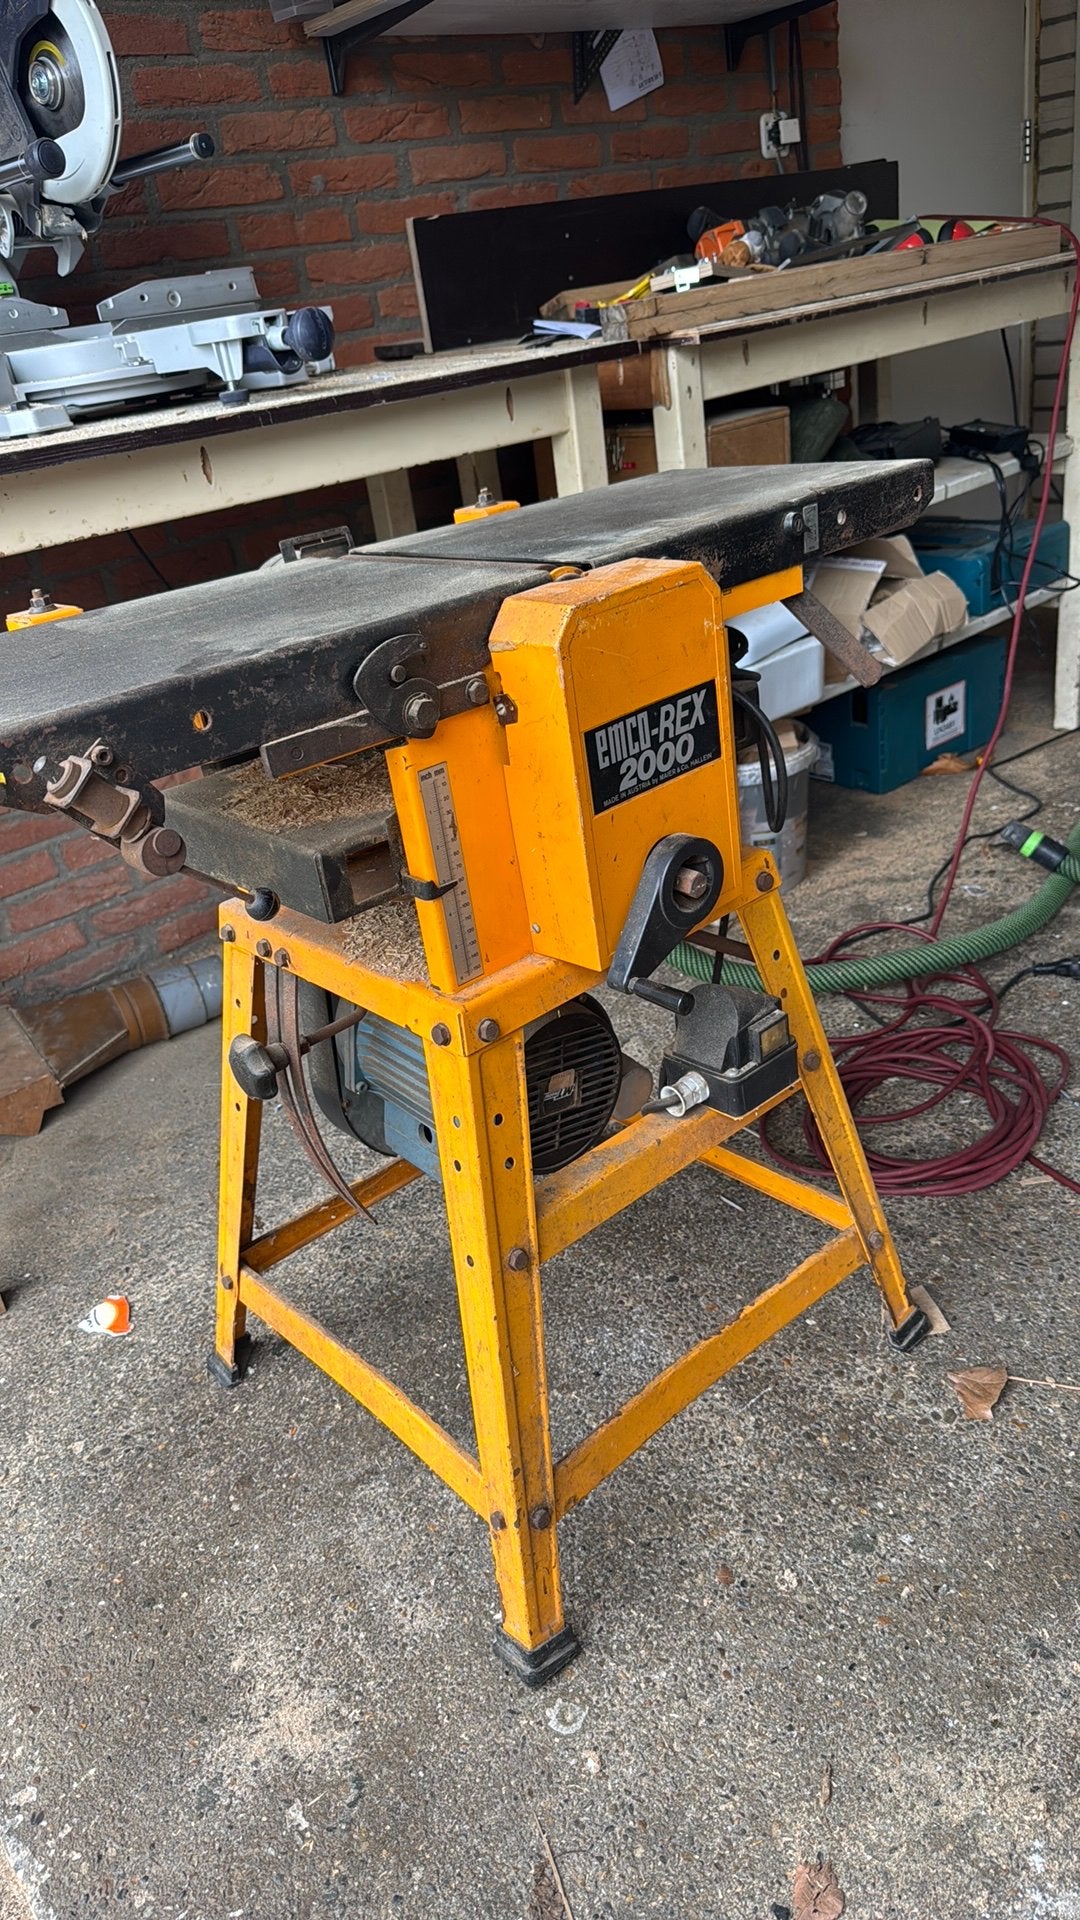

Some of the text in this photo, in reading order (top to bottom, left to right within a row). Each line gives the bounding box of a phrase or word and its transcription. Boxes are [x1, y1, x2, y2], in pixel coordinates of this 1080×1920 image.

[420, 767, 445, 782] inch mm
[603, 794, 620, 807] MADE
[620, 791, 627, 800] IN
[627, 780, 652, 796] AUSTRIA
[651, 777, 658, 785] by
[659, 768, 677, 781] MAIER
[690, 753, 713, 767] HALLEIN
[619, 733, 694, 792] 2000
